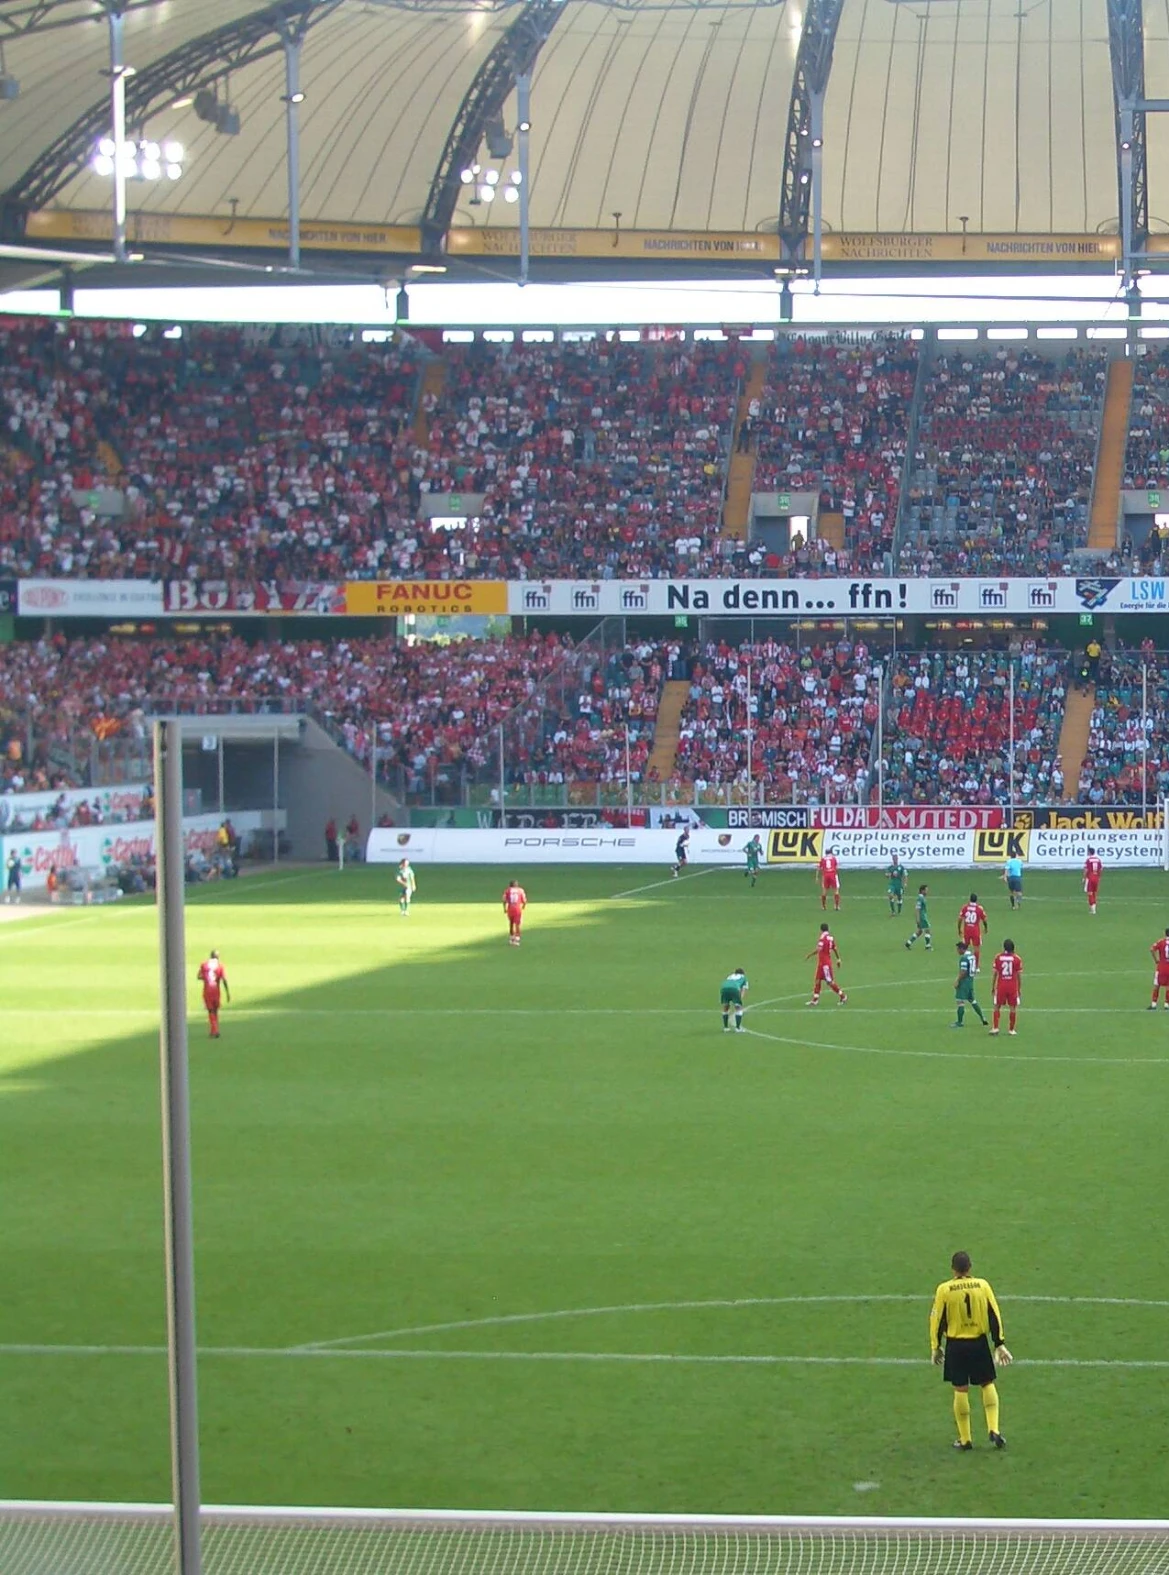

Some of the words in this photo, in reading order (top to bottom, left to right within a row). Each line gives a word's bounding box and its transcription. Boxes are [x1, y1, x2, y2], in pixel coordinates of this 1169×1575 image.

[713, 240, 735, 251] VON
[840, 235, 933, 247] WOLFSBURGER
[987, 242, 1054, 253] NACHRICHTEN
[1056, 242, 1075, 253] VON
[376, 583, 473, 600] FANUC
[667, 585, 709, 609] Na
[722, 583, 835, 610] denn...
[848, 583, 907, 609] ffn!
[933, 589, 955, 606] ffn
[981, 589, 1003, 606] ffn
[1031, 589, 1052, 606] ffn
[1131, 581, 1165, 600] LSW
[525, 591, 547, 608] ffn
[574, 591, 596, 608] ffn
[622, 591, 645, 608] ffn
[377, 604, 472, 613] ROBOTICS
[809, 807, 867, 827] FULDA
[866, 808, 993, 829] LAMSTEDT
[1040, 811, 1101, 830] Jack
[504, 837, 636, 847] PORSCHE
[832, 831, 934, 842] Kupplungen
[937, 831, 966, 841] und
[1037, 831, 1140, 842] Kupplungen
[830, 844, 966, 861] Getriebesysteme
[964, 911, 977, 923] 20
[1001, 961, 1013, 976] 21
[964, 1293, 972, 1319] 1
